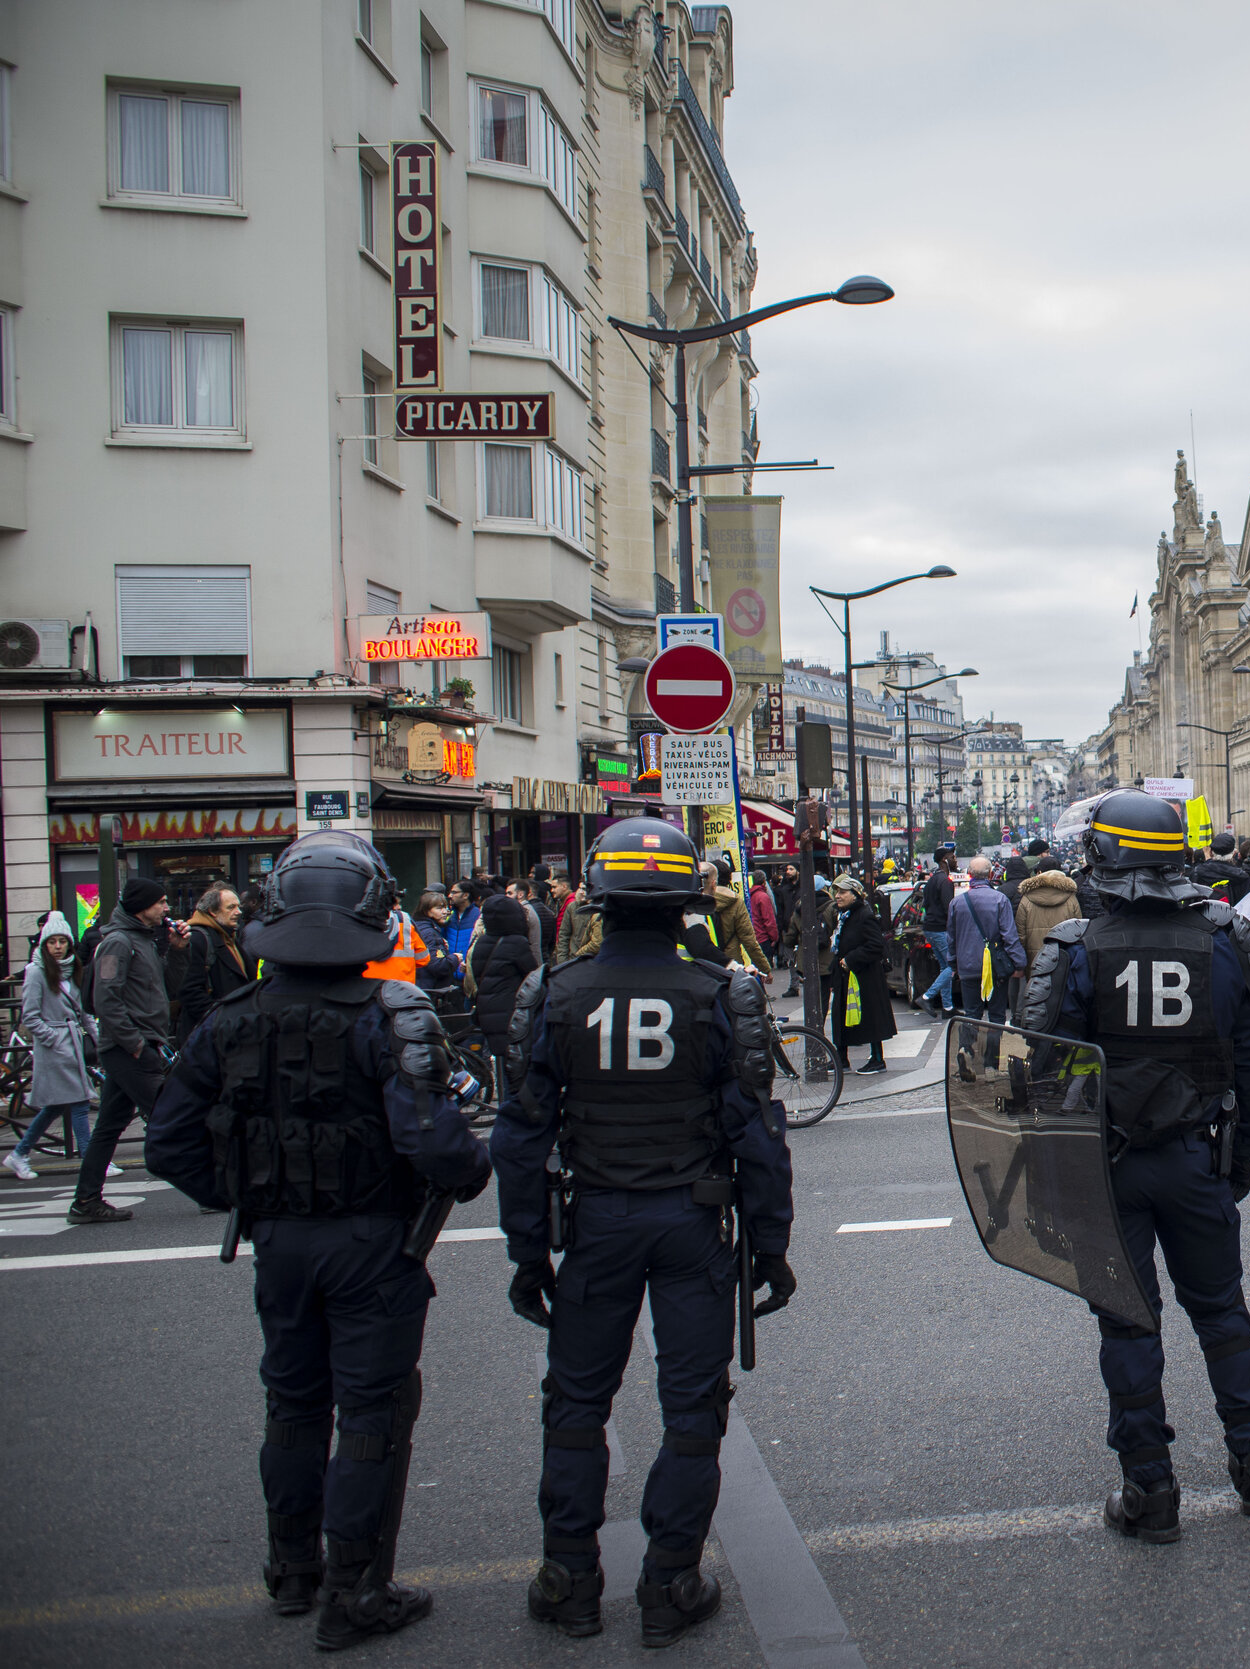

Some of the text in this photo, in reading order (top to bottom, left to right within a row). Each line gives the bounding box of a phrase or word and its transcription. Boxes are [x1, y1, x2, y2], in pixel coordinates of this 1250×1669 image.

[397, 156, 436, 386] HOTEL
[404, 401, 543, 431] PICARDY
[711, 529, 776, 543] RESPECTEZ
[726, 558, 777, 569] KLAXONNEZ
[736, 570, 754, 581] PAS
[386, 616, 461, 635] Artisan
[682, 628, 698, 636] ZONE
[365, 637, 478, 659] BOULANGER
[769, 683, 781, 750] HOTEL
[632, 720, 664, 729] SANDW
[94, 732, 248, 758] TRAITEUR
[671, 740, 723, 749] SAUF BUS
[649, 733, 657, 770] KEBAB
[665, 750, 728, 759] TAXIS-VÉLOS
[757, 751, 797, 761] RICHMOND
[664, 760, 730, 769] RIVERAINS-PAM
[666, 771, 728, 780] LIVRAISONS
[665, 781, 713, 790] VÉHICULE
[717, 781, 729, 789] DE
[517, 777, 608, 815] PICARDY HOTEL
[676, 791, 720, 800] SERVICE
[319, 820, 333, 829] 159
[704, 821, 726, 835] ERCI
[704, 836, 719, 846] AUX
[1115, 960, 1193, 1027] 1B
[586, 997, 675, 1071] 1B
